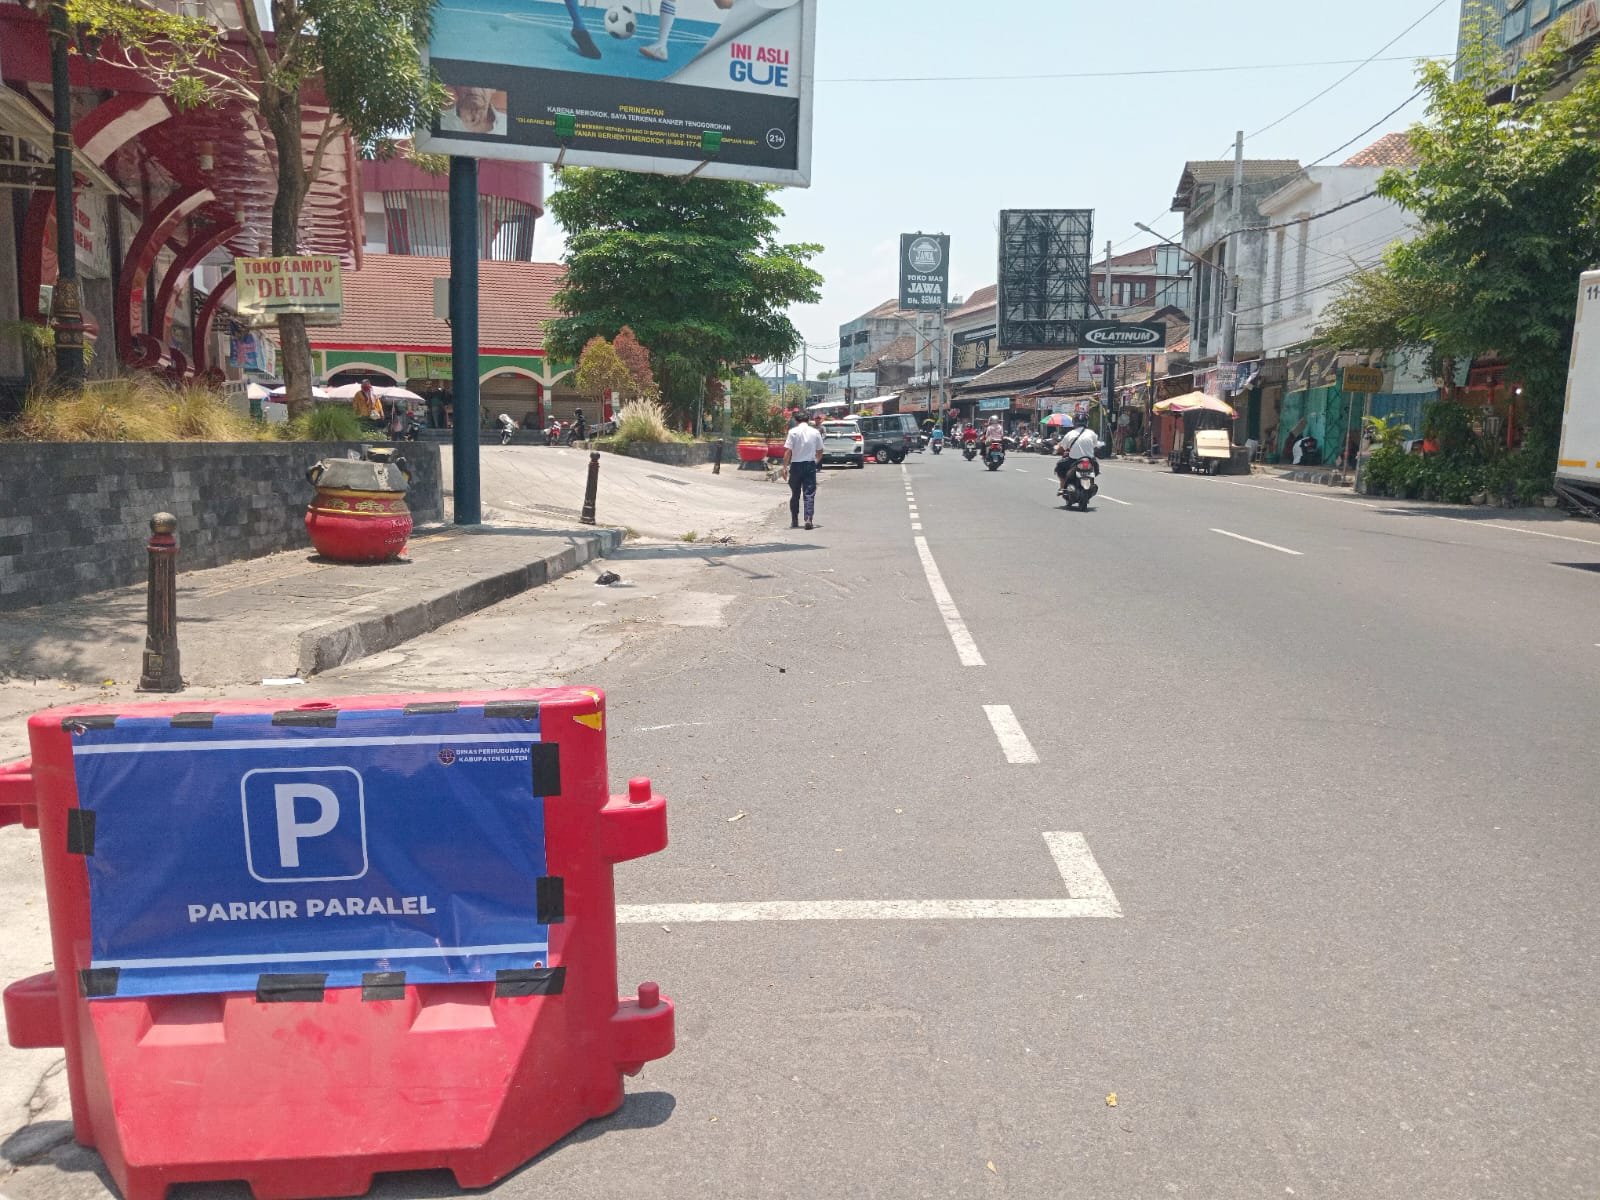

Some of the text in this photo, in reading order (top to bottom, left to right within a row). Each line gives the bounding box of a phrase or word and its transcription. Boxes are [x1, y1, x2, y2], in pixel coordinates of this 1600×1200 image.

[731, 43, 789, 65] INI ASLI
[729, 60, 788, 87] GUE
[618, 104, 664, 116] PERINGATAN
[547, 106, 575, 115] KARENA
[628, 114, 657, 123] TERKENA
[685, 120, 731, 130] TENGGOROKAN
[597, 132, 631, 141] BERHENTI
[631, 135, 665, 145] MEROKOK
[769, 134, 783, 143] 21+
[243, 260, 333, 274] TOKO LAMPU
[246, 277, 333, 298] "DELTA"
[907, 282, 942, 294] JAWA
[920, 295, 942, 304] SEMAR
[1093, 331, 1151, 341] PLATINUM
[478, 747, 530, 755] PERHUBUNGAN
[274, 783, 340, 868] P
[187, 896, 437, 923] PARKIR PARALEL
